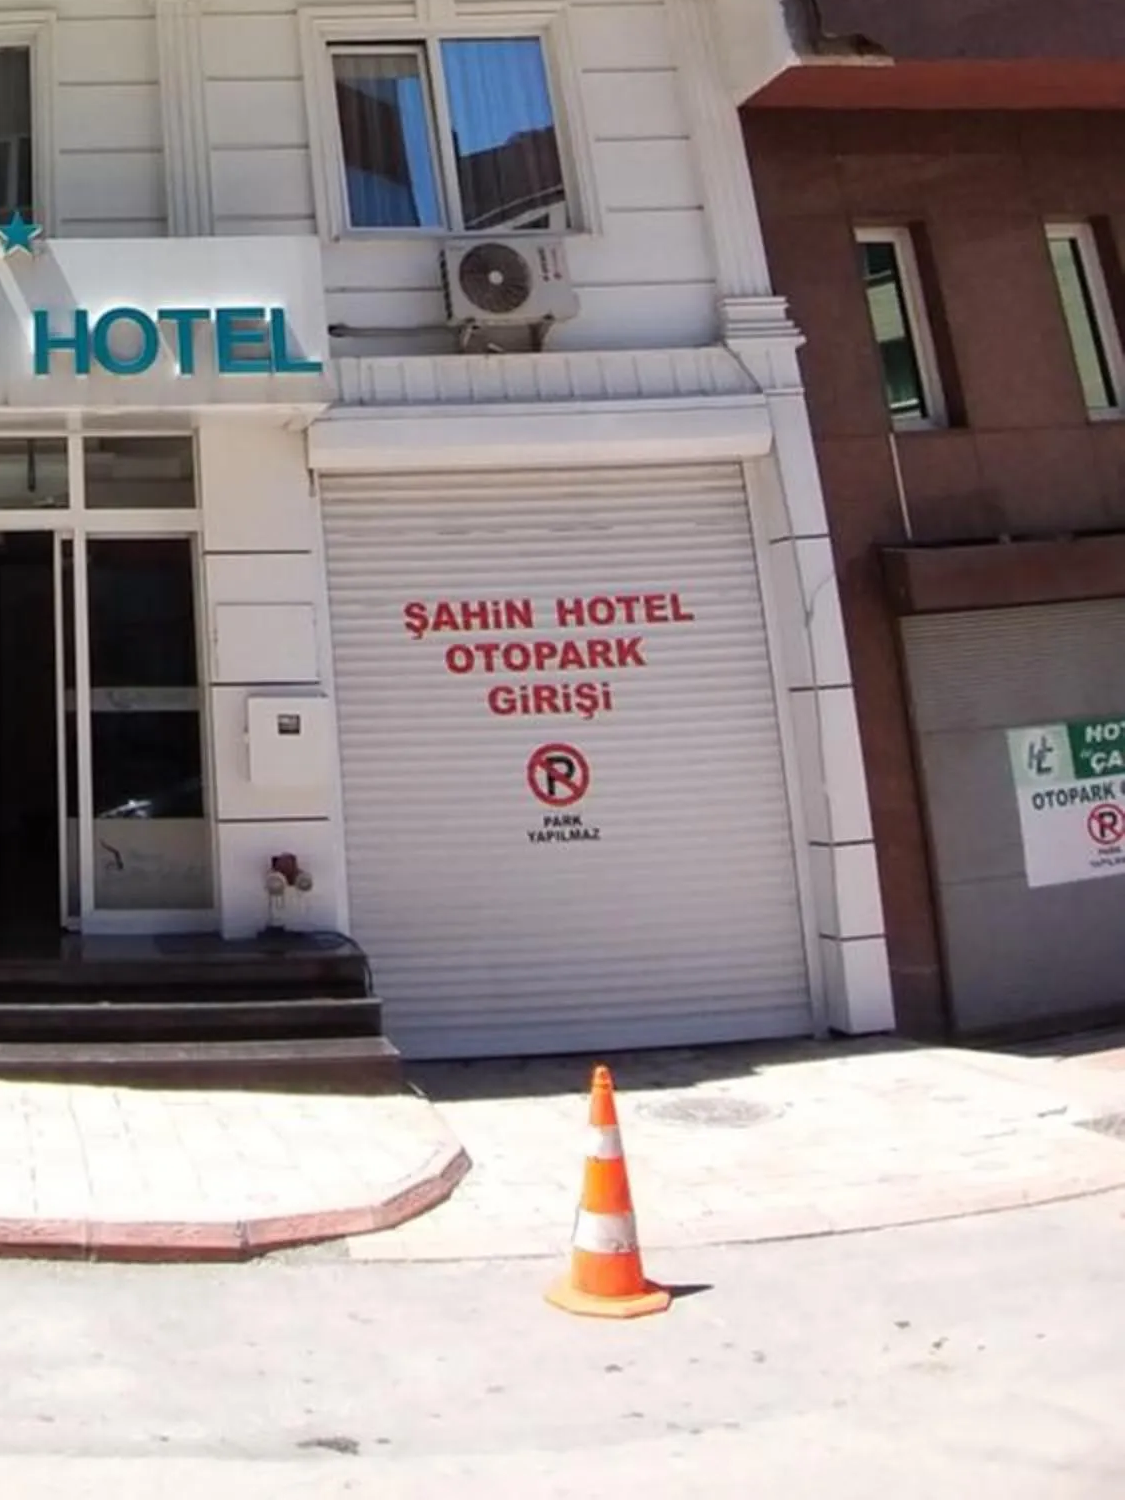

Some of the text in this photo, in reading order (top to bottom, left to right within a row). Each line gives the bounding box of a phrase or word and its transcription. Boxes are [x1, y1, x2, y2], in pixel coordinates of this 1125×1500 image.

[31, 306, 324, 377] HOTEL
[556, 592, 695, 627] HOTEL
[445, 636, 647, 674] OTOPARK
[1085, 721, 1125, 744] HO
[1032, 782, 1116, 811] OTOPARK
[528, 828, 601, 843] YAPILMAZ
[544, 815, 583, 828] PARK
